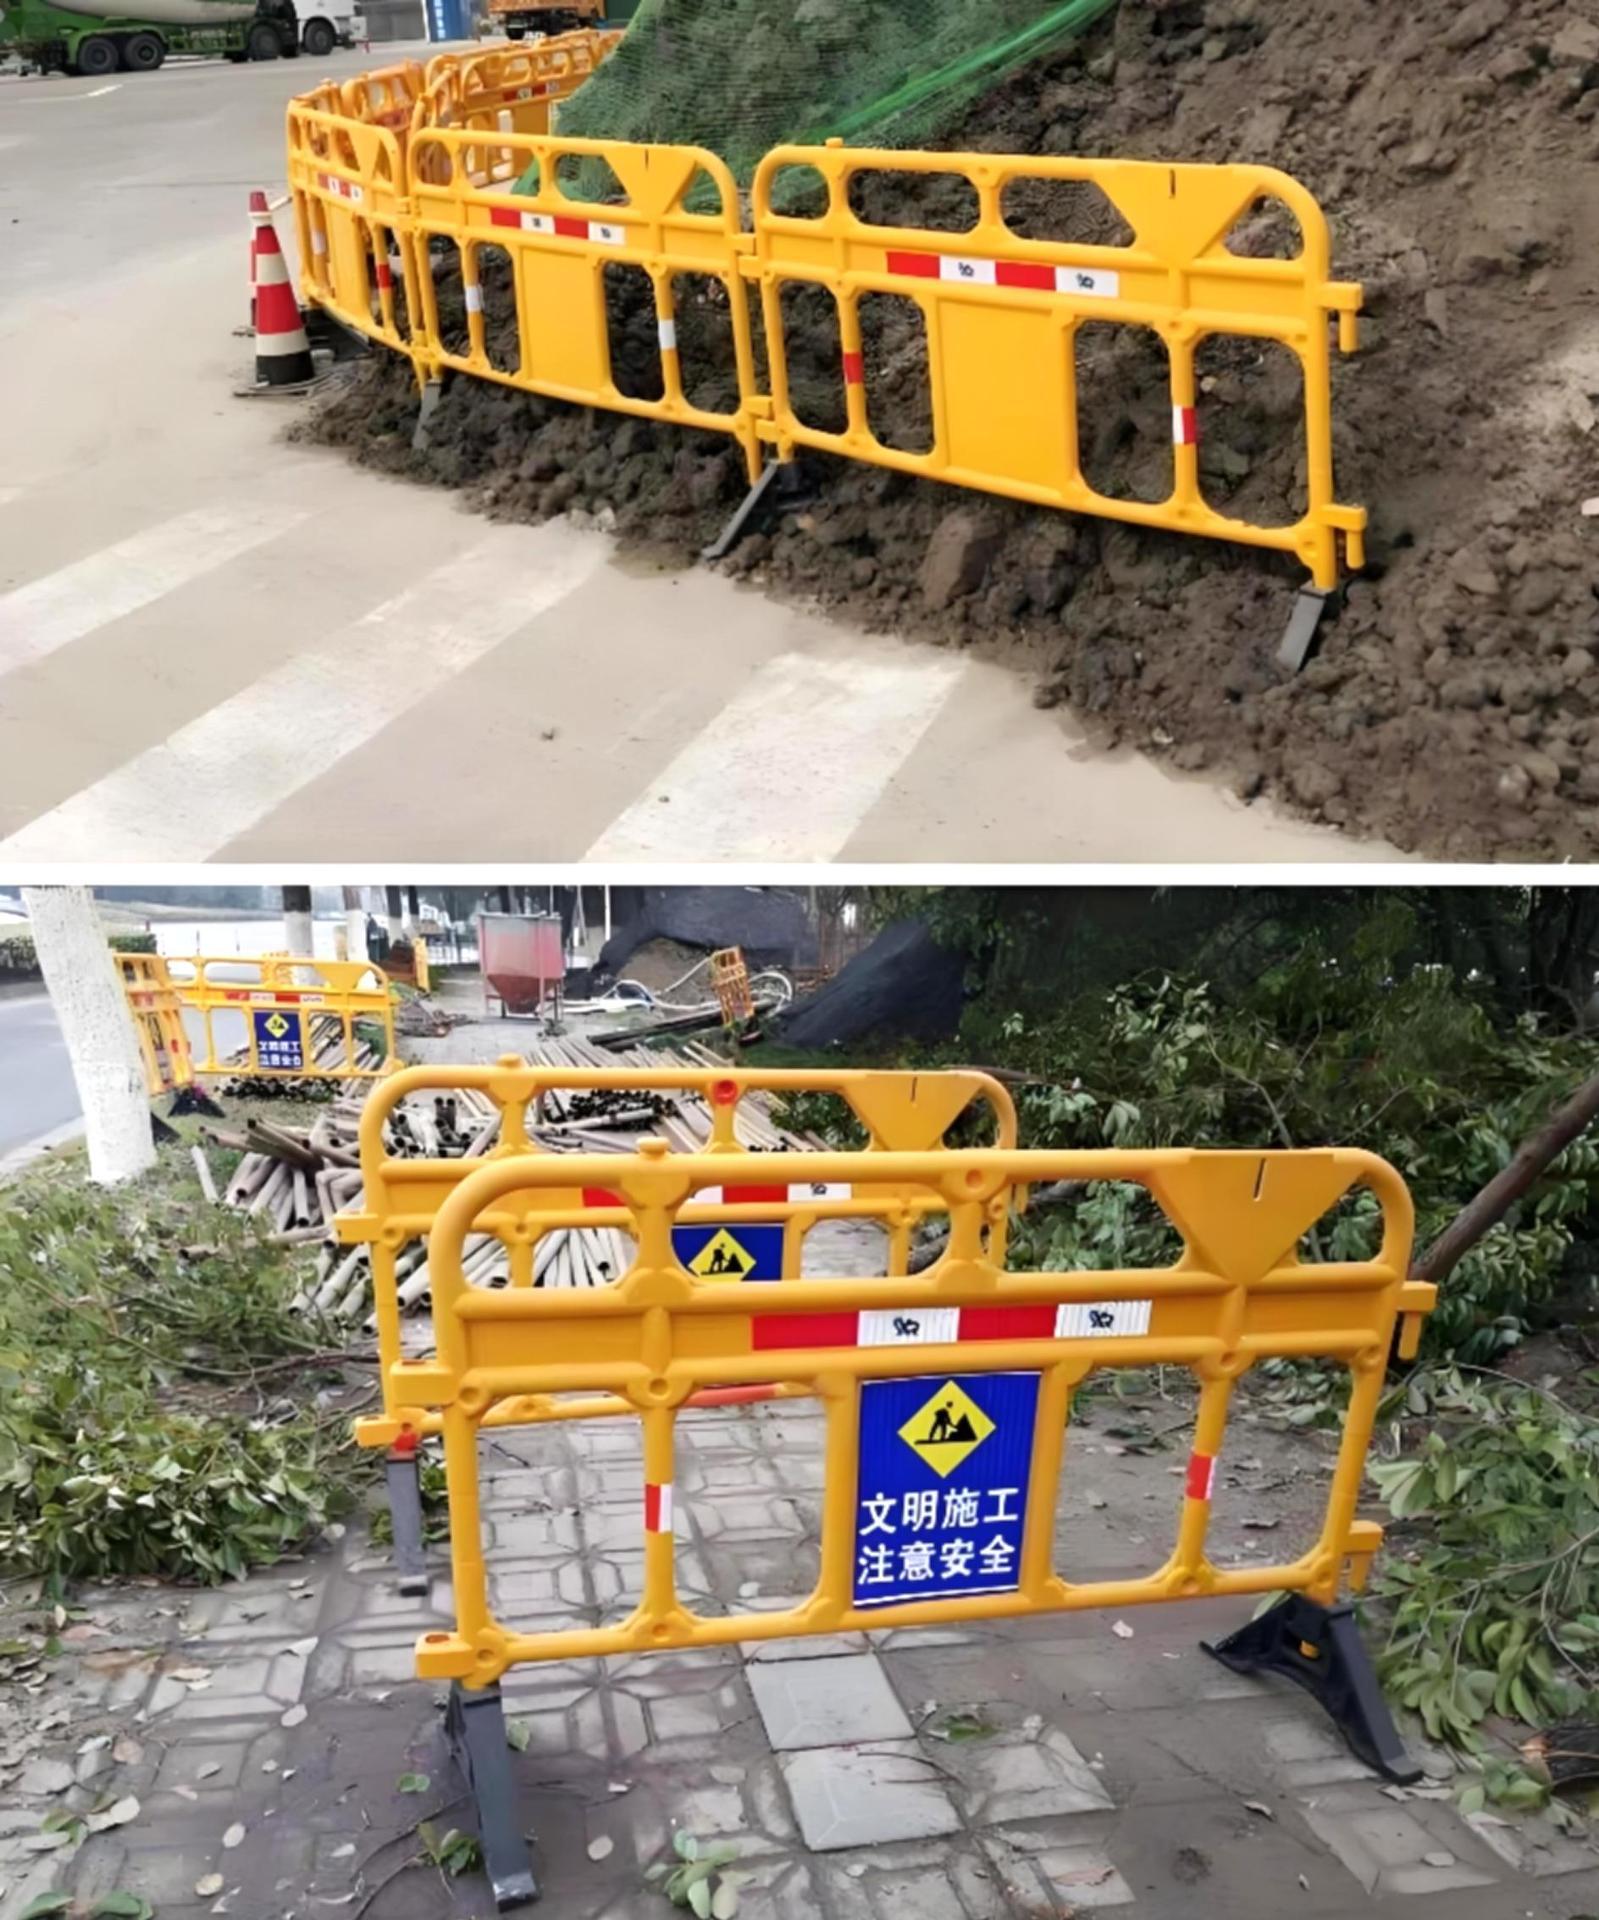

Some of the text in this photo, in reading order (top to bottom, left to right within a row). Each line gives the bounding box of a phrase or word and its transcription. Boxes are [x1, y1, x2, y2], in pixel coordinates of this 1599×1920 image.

[858, 1486, 1020, 1536] 文明施工
[857, 1533, 1016, 1586] 注意安全
